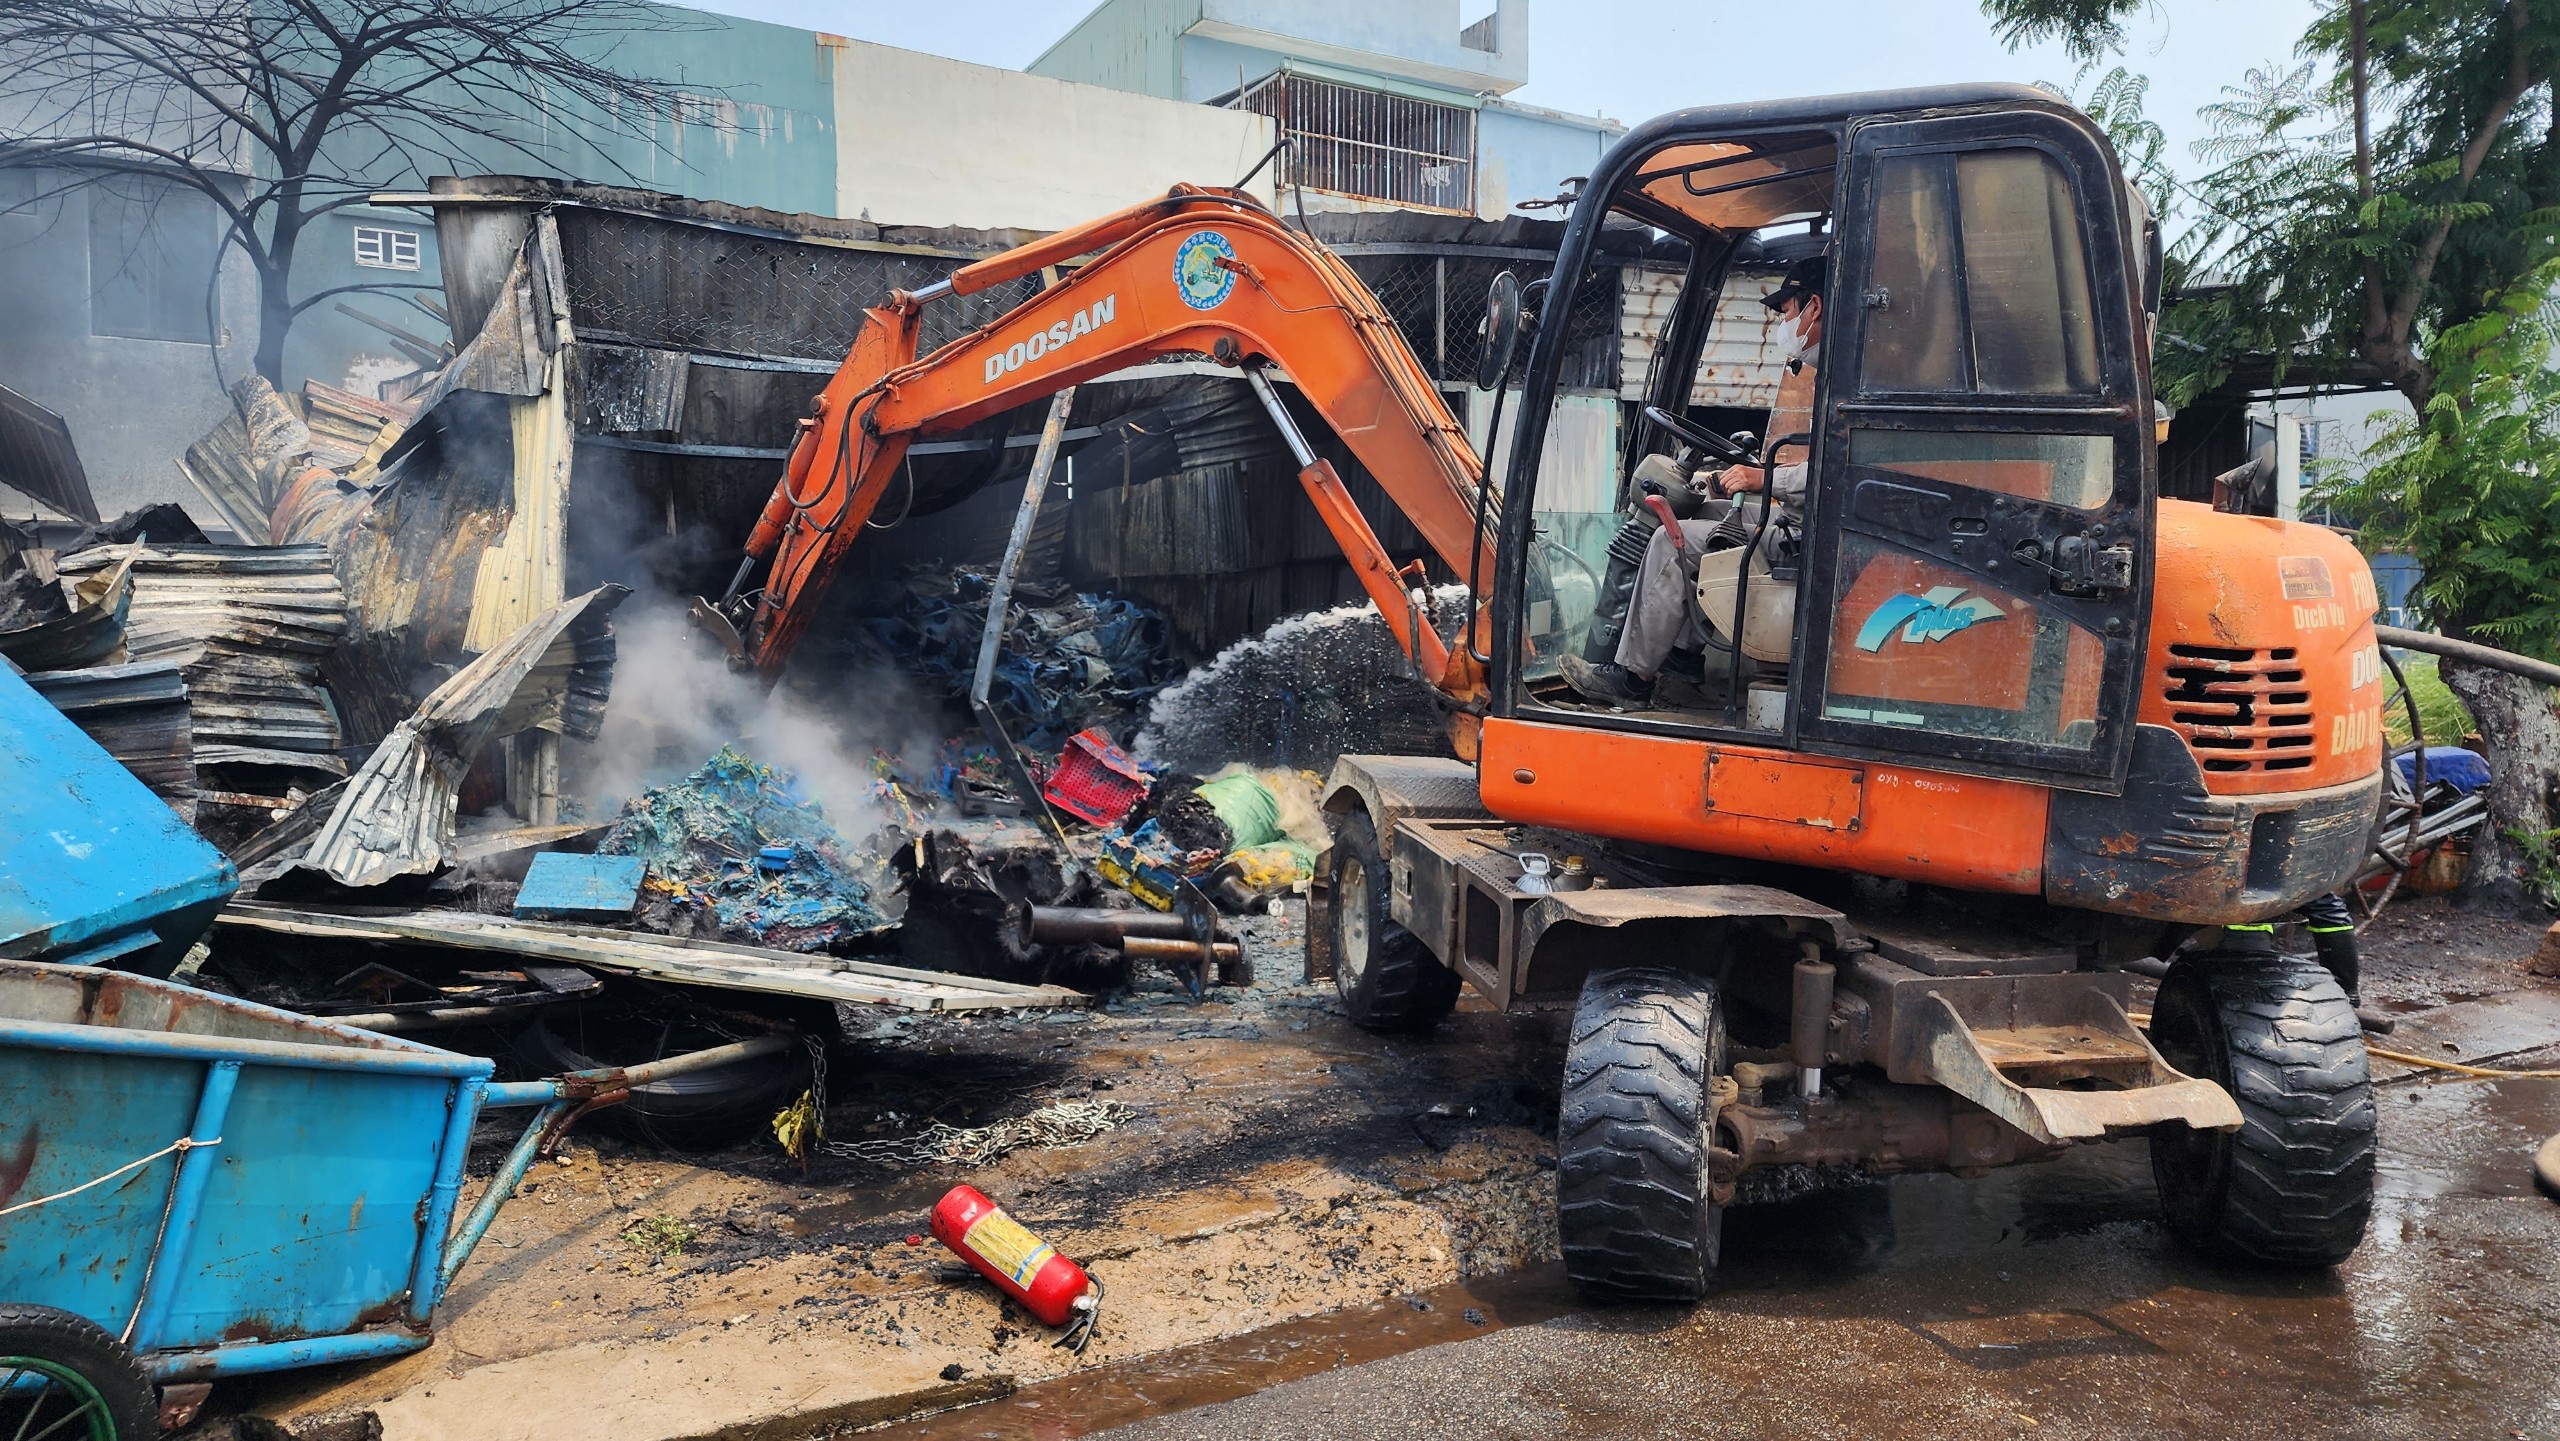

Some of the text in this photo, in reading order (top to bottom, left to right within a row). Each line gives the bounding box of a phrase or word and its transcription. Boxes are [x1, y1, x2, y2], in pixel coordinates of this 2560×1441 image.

[984, 292, 1115, 385] DOOSAN
[1909, 604, 1976, 636] plus
[2293, 602, 2346, 634] Dịch Vụ
[2331, 704, 2366, 756] ĐÀO
